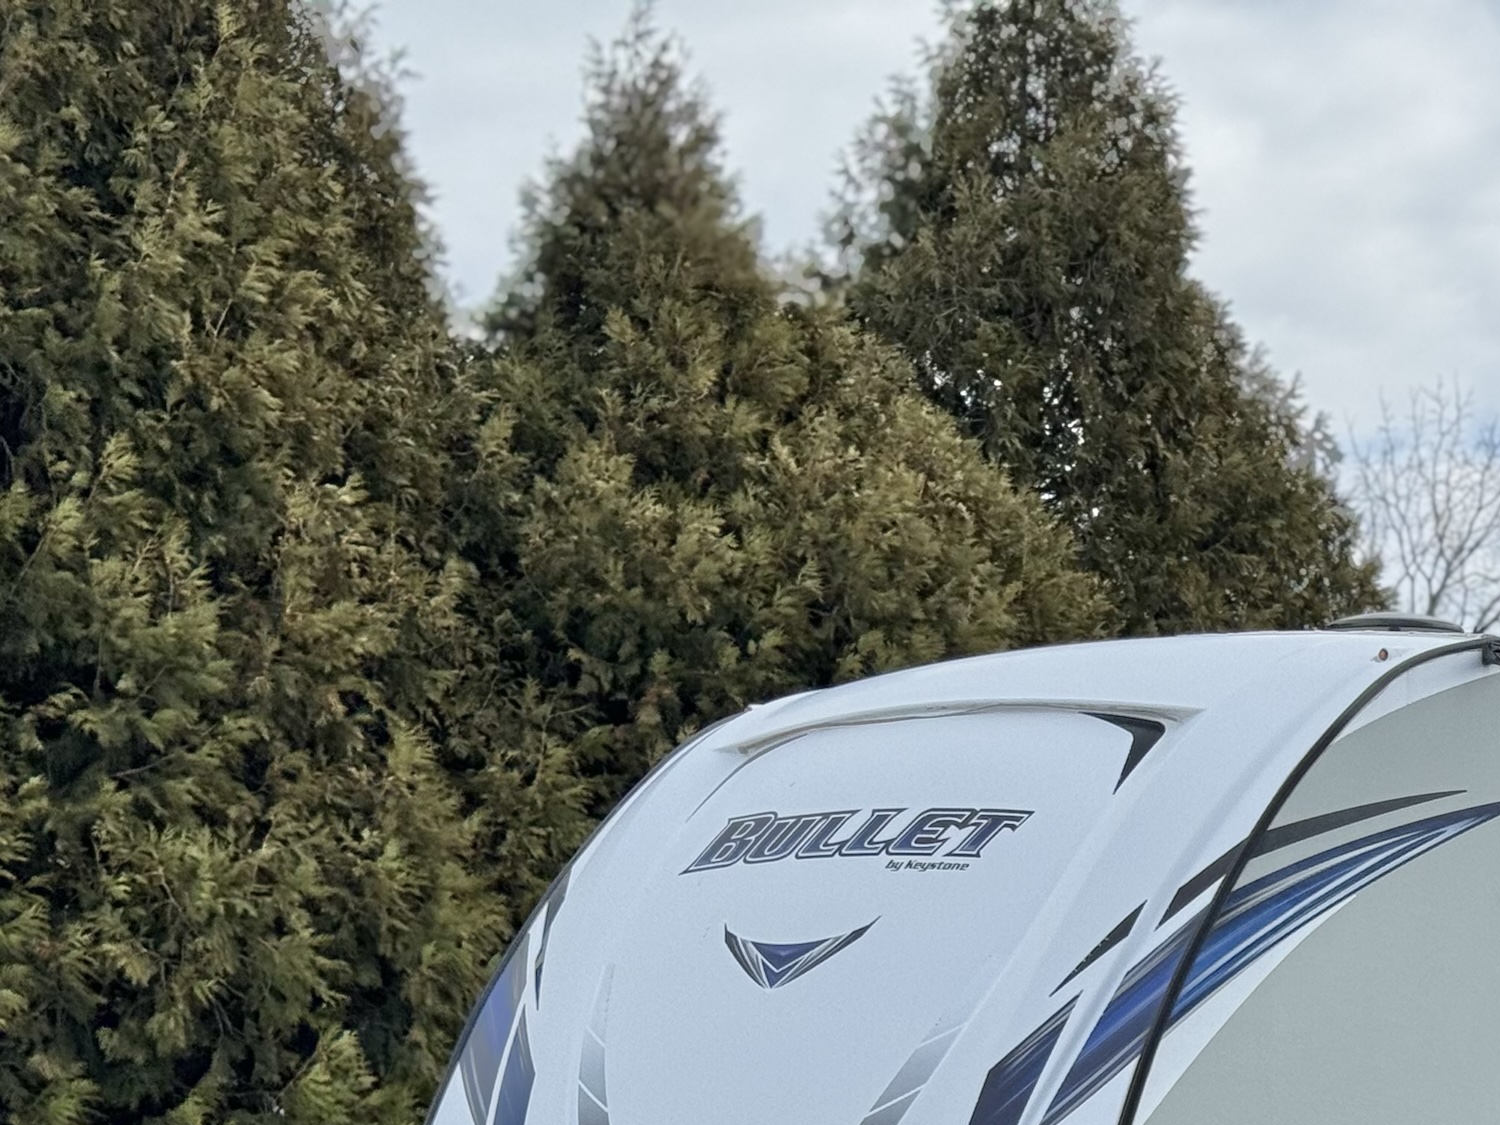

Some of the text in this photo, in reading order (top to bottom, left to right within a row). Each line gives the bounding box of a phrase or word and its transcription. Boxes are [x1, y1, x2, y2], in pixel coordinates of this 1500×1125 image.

[678, 807, 1035, 875] BULLET
[884, 859, 970, 872] by Keystone
